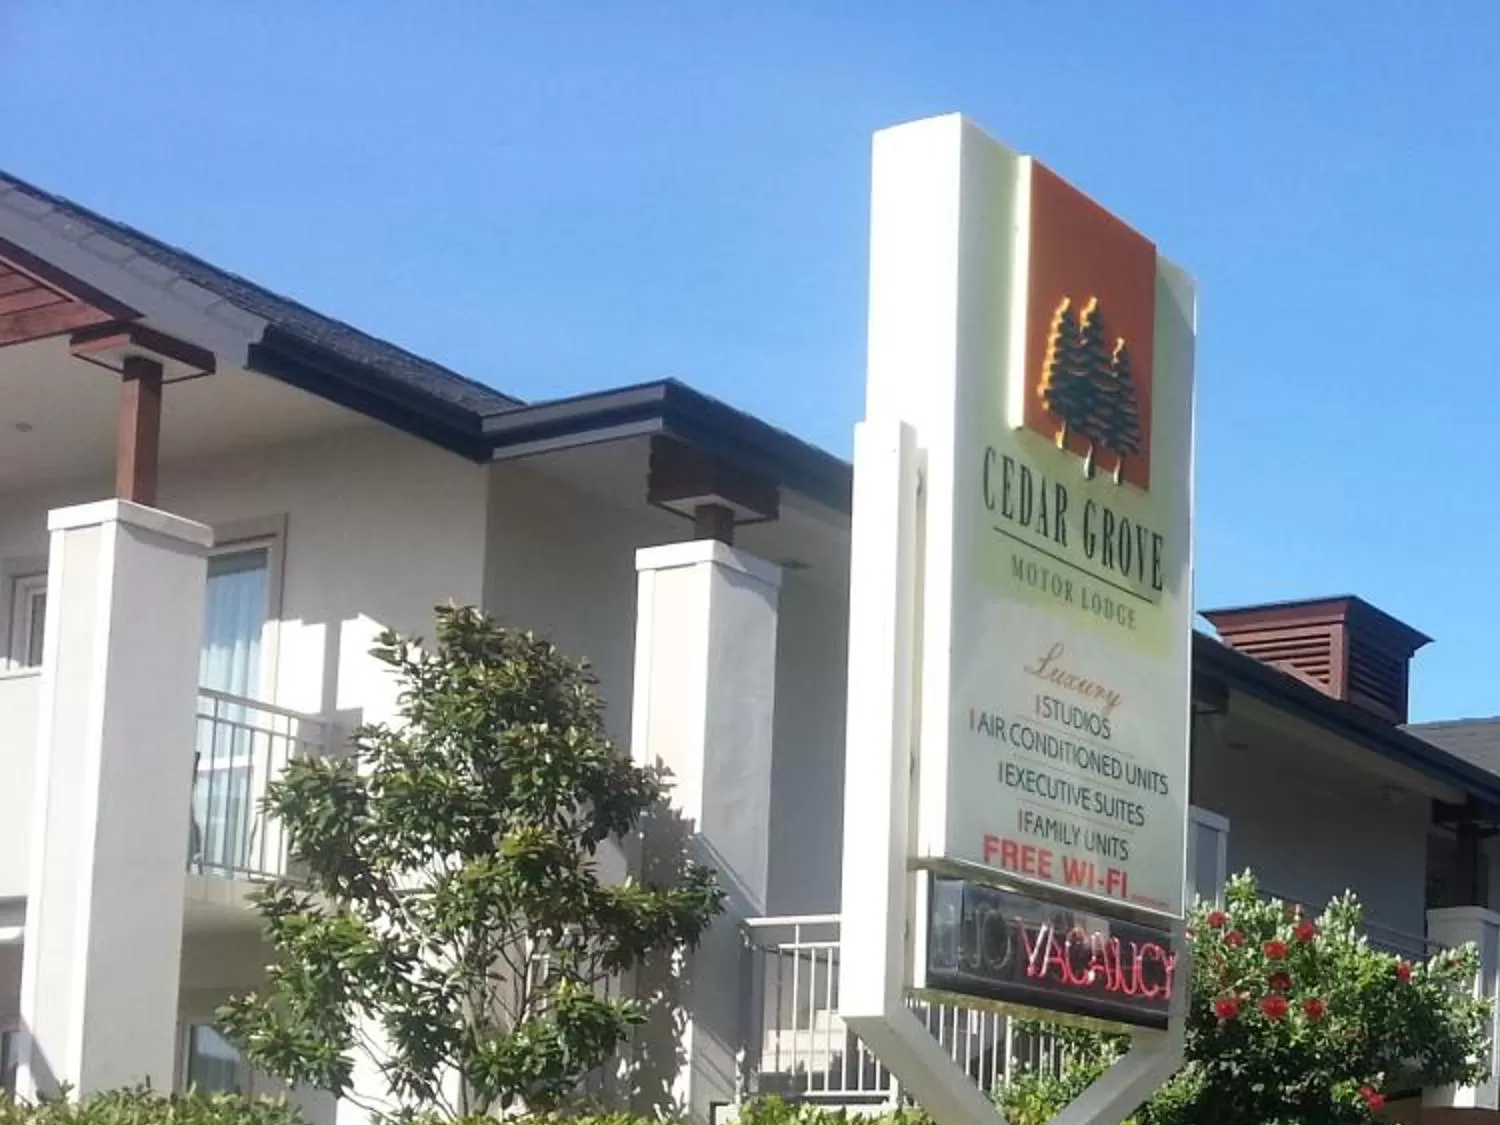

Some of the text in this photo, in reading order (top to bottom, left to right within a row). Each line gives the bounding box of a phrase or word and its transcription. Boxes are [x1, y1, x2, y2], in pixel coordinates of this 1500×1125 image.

[983, 446, 1164, 591] CEDAR GROVE
[1012, 554, 1137, 630] MOTOR LODGE
[1024, 642, 1122, 714] Luxury
[978, 712, 1169, 795] AIR CONDITIONED UNITS
[1084, 831, 1129, 861] UNITS
[1094, 791, 1145, 827] SUITES
[982, 834, 1128, 898] FREE WI-FI
[1013, 916, 1178, 1000] VACANCY
